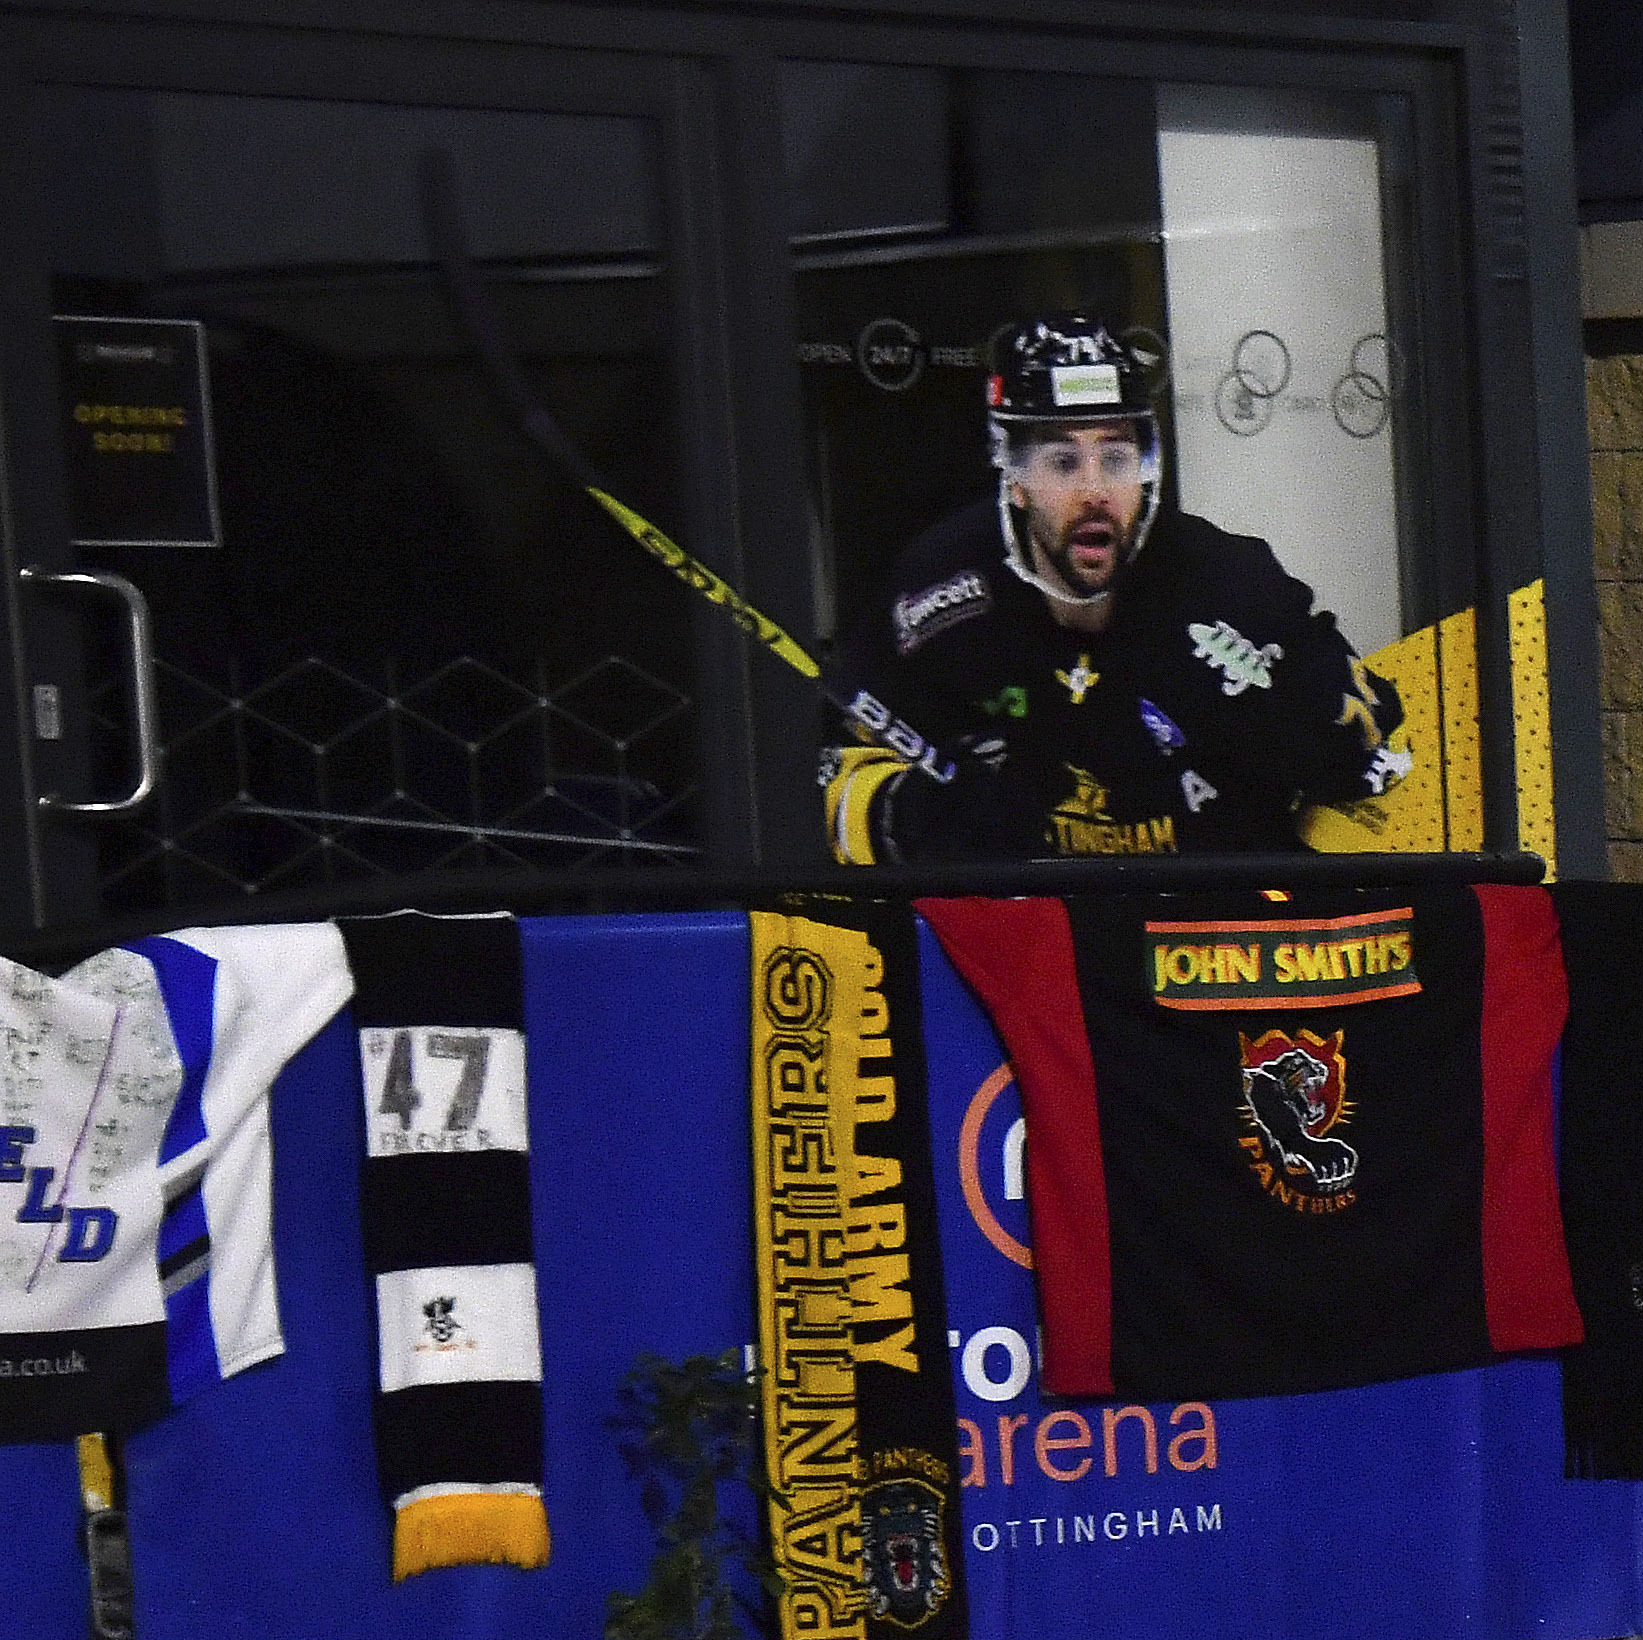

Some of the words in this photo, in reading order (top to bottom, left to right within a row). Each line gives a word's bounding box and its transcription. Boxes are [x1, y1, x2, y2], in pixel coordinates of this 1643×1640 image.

[1153, 942, 1261, 992] JOHN
[1272, 930, 1414, 985] SMITH'S
[844, 1153, 920, 1375] ARMY
